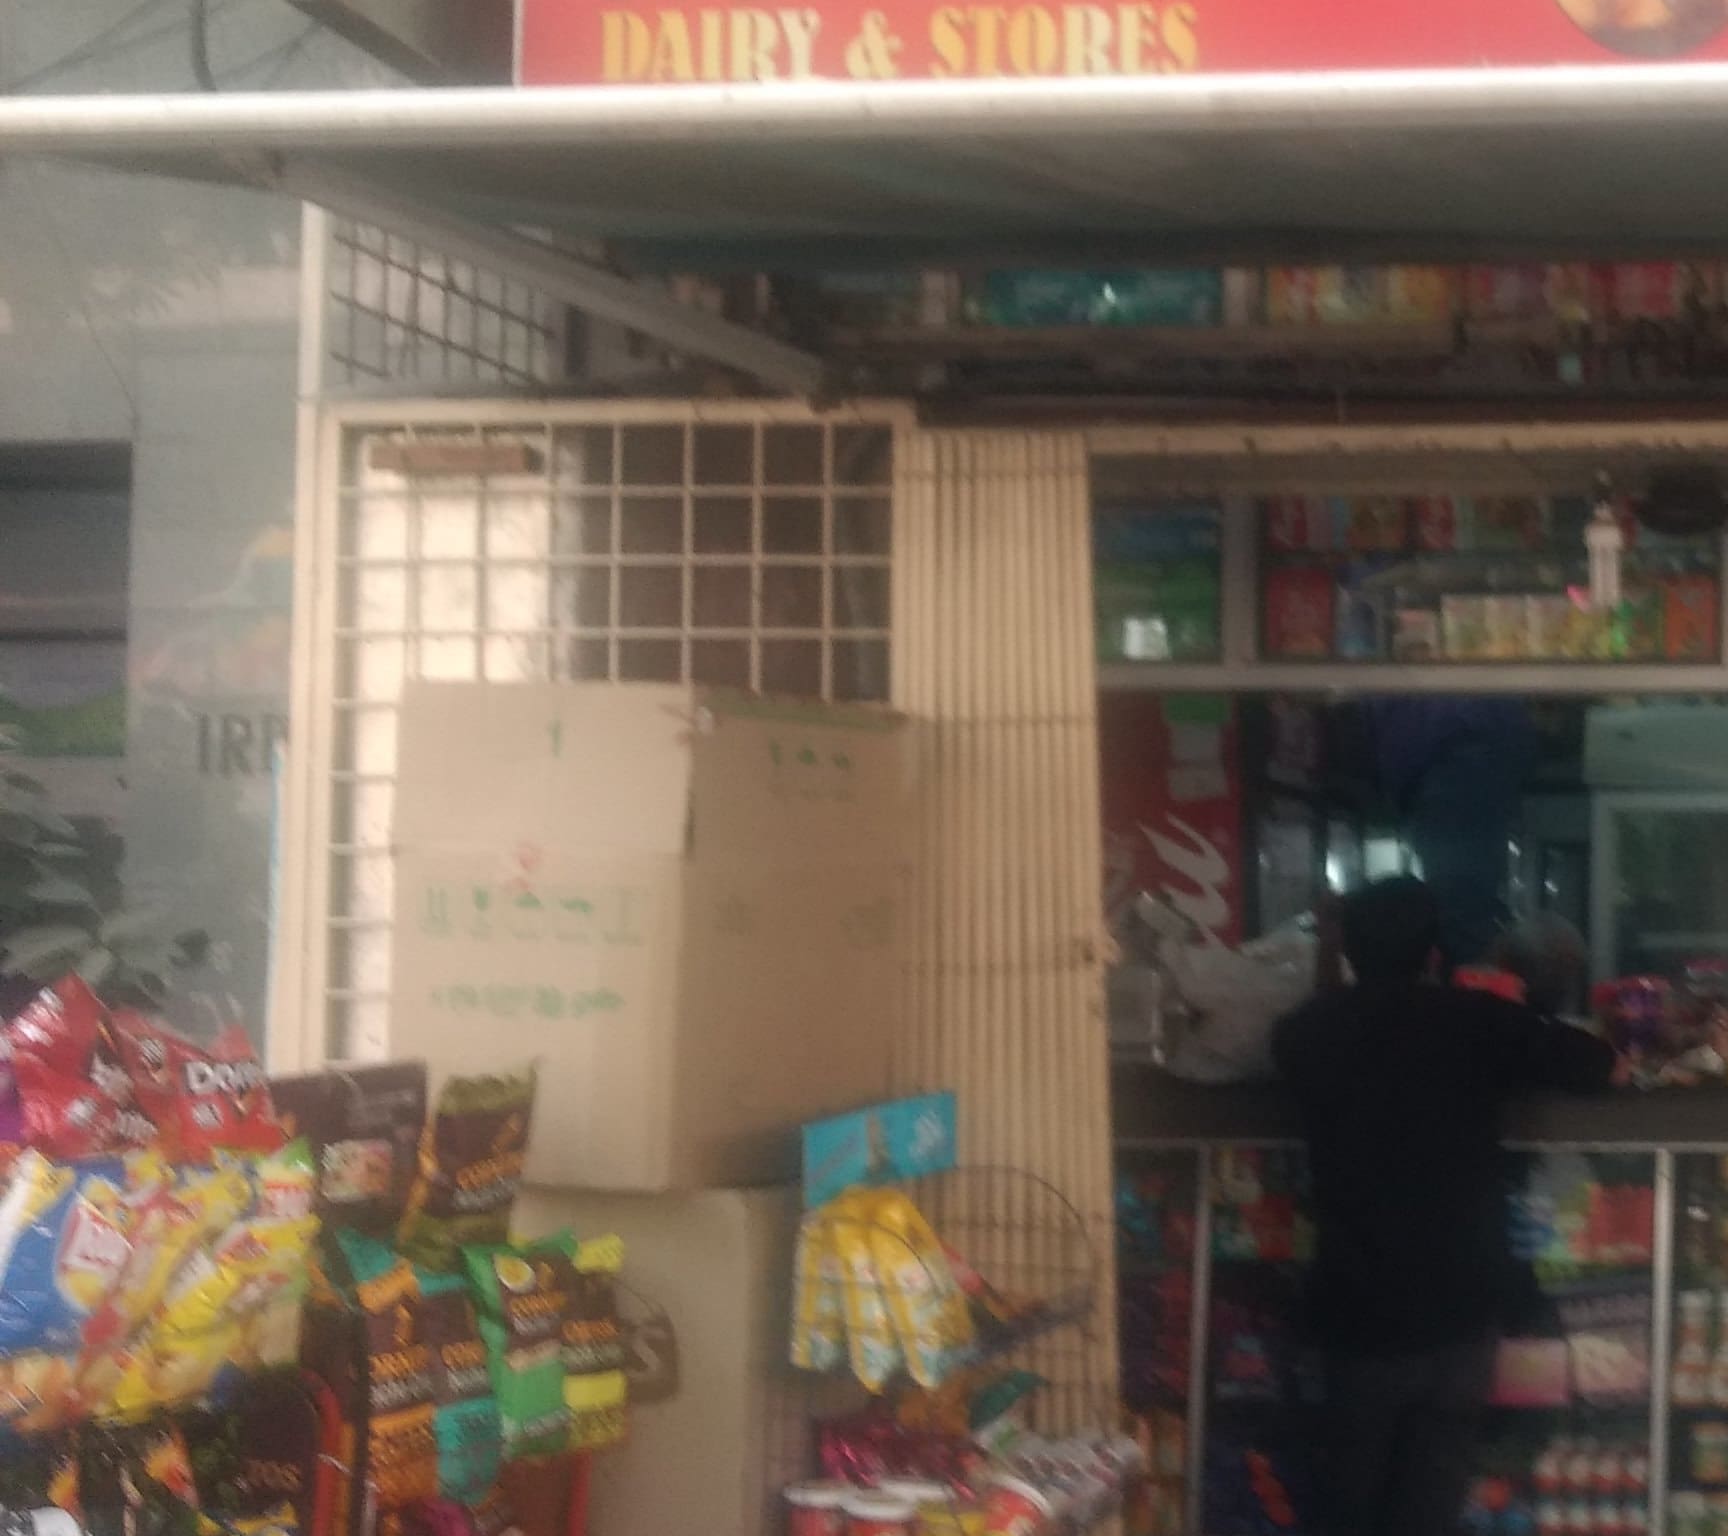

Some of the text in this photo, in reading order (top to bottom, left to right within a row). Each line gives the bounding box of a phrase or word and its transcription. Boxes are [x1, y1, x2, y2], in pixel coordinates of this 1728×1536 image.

[602, 3, 1198, 82] DAIRY & STORES
